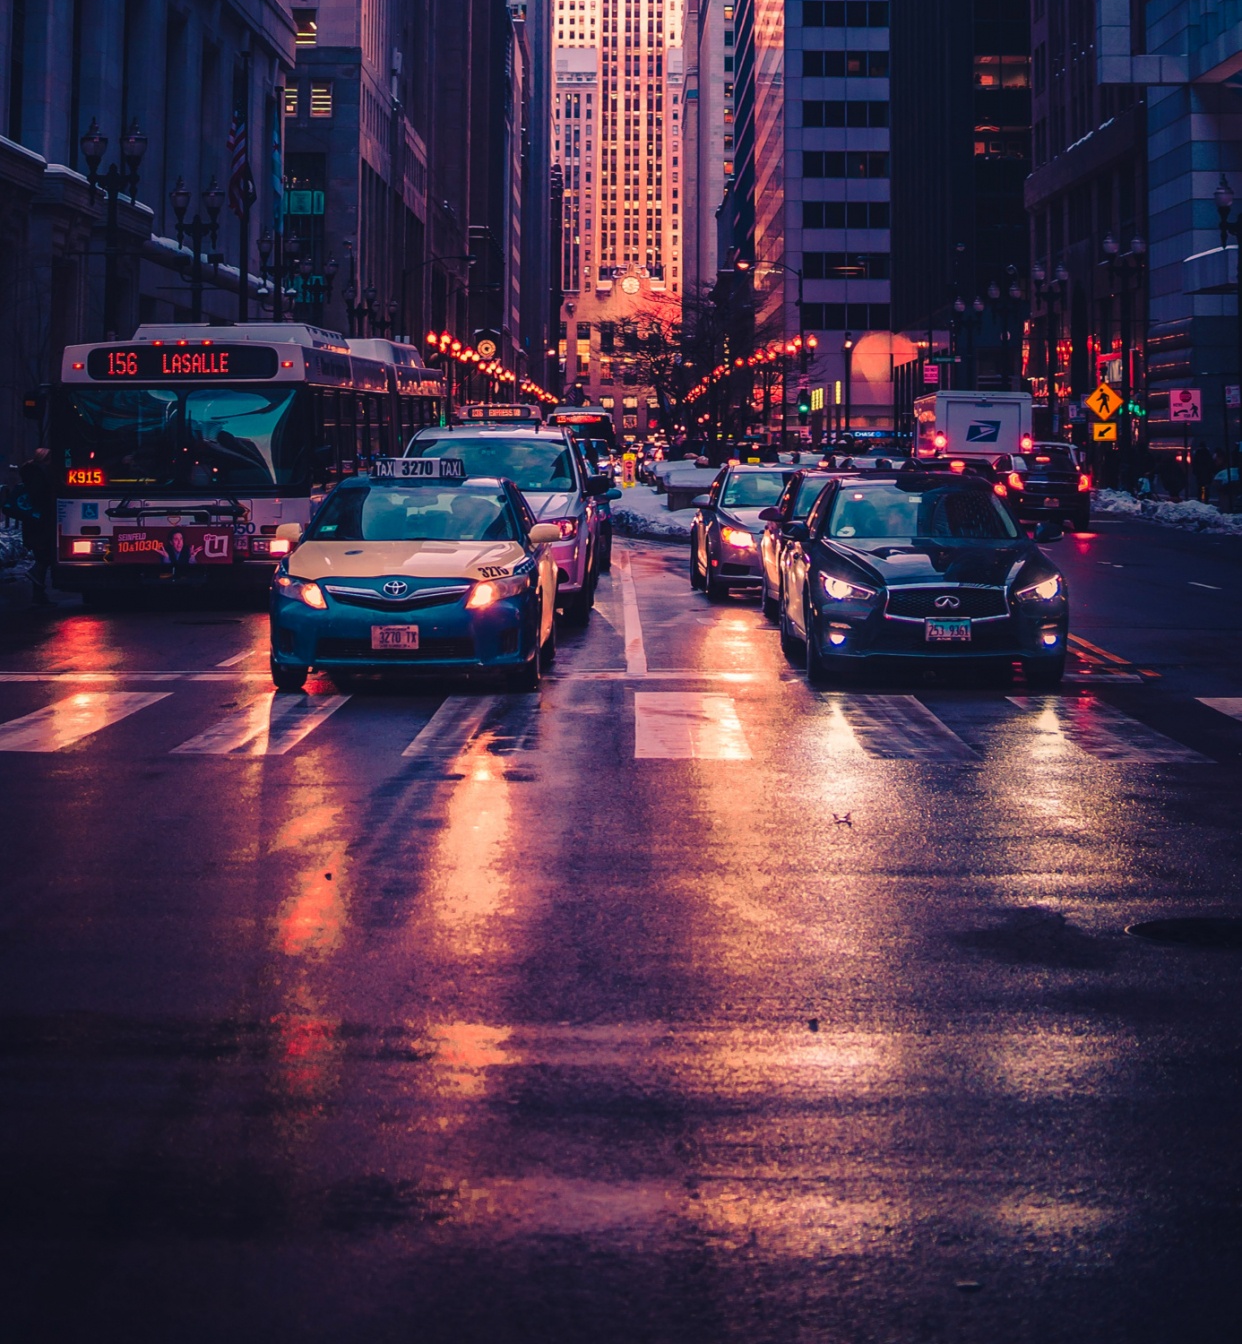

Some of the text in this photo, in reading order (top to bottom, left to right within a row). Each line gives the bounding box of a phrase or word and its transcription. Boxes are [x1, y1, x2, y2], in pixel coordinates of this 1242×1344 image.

[107, 352, 229, 375] 156 LASALLE
[375, 460, 461, 477] TAXI 3270 TAXI
[68, 471, 102, 484] K915
[118, 532, 147, 542] SEINFELD
[477, 566, 509, 578] 3270
[928, 624, 969, 636] 253 9361
[379, 631, 417, 644] 3270 TX
